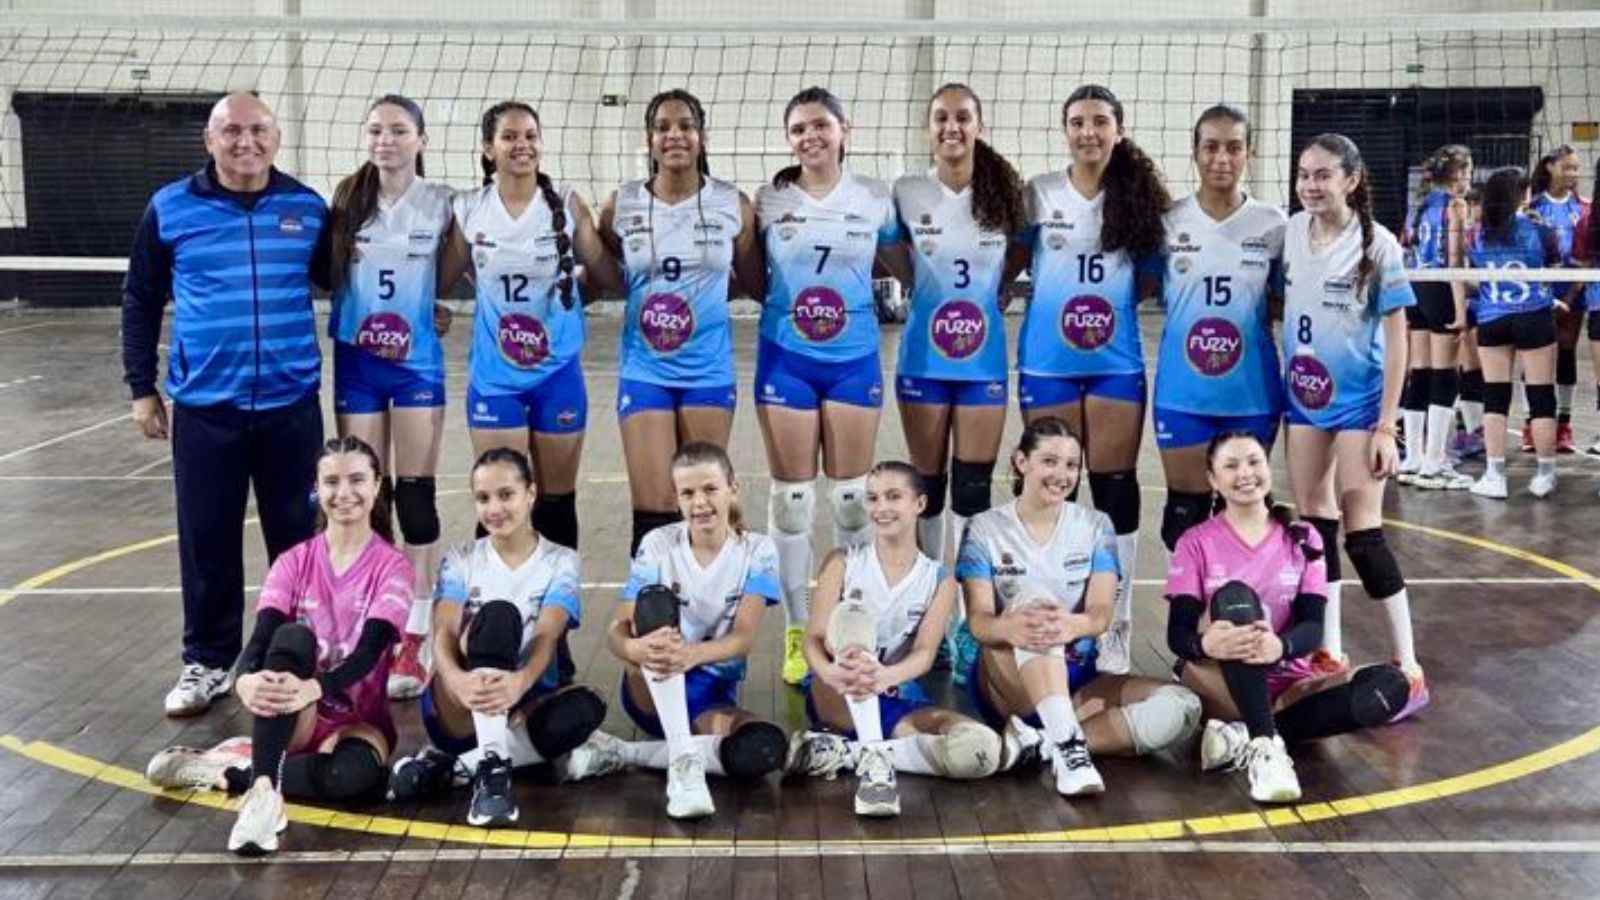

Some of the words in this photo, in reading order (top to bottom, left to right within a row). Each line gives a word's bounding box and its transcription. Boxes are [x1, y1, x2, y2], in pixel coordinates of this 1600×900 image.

[661, 256, 682, 282] 9
[814, 245, 832, 275] 7
[953, 258, 971, 289] 3
[1077, 253, 1105, 284] 16
[379, 269, 396, 300] 5
[500, 273, 530, 302] 12
[1203, 275, 1232, 307] 15
[642, 309, 690, 330] FUZZY
[934, 319, 983, 334] FUZZY
[1063, 312, 1113, 328] FUZZY
[1297, 314, 1312, 345] 8
[358, 330, 409, 345] FUZZY
[1188, 335, 1240, 353] FUZZY
